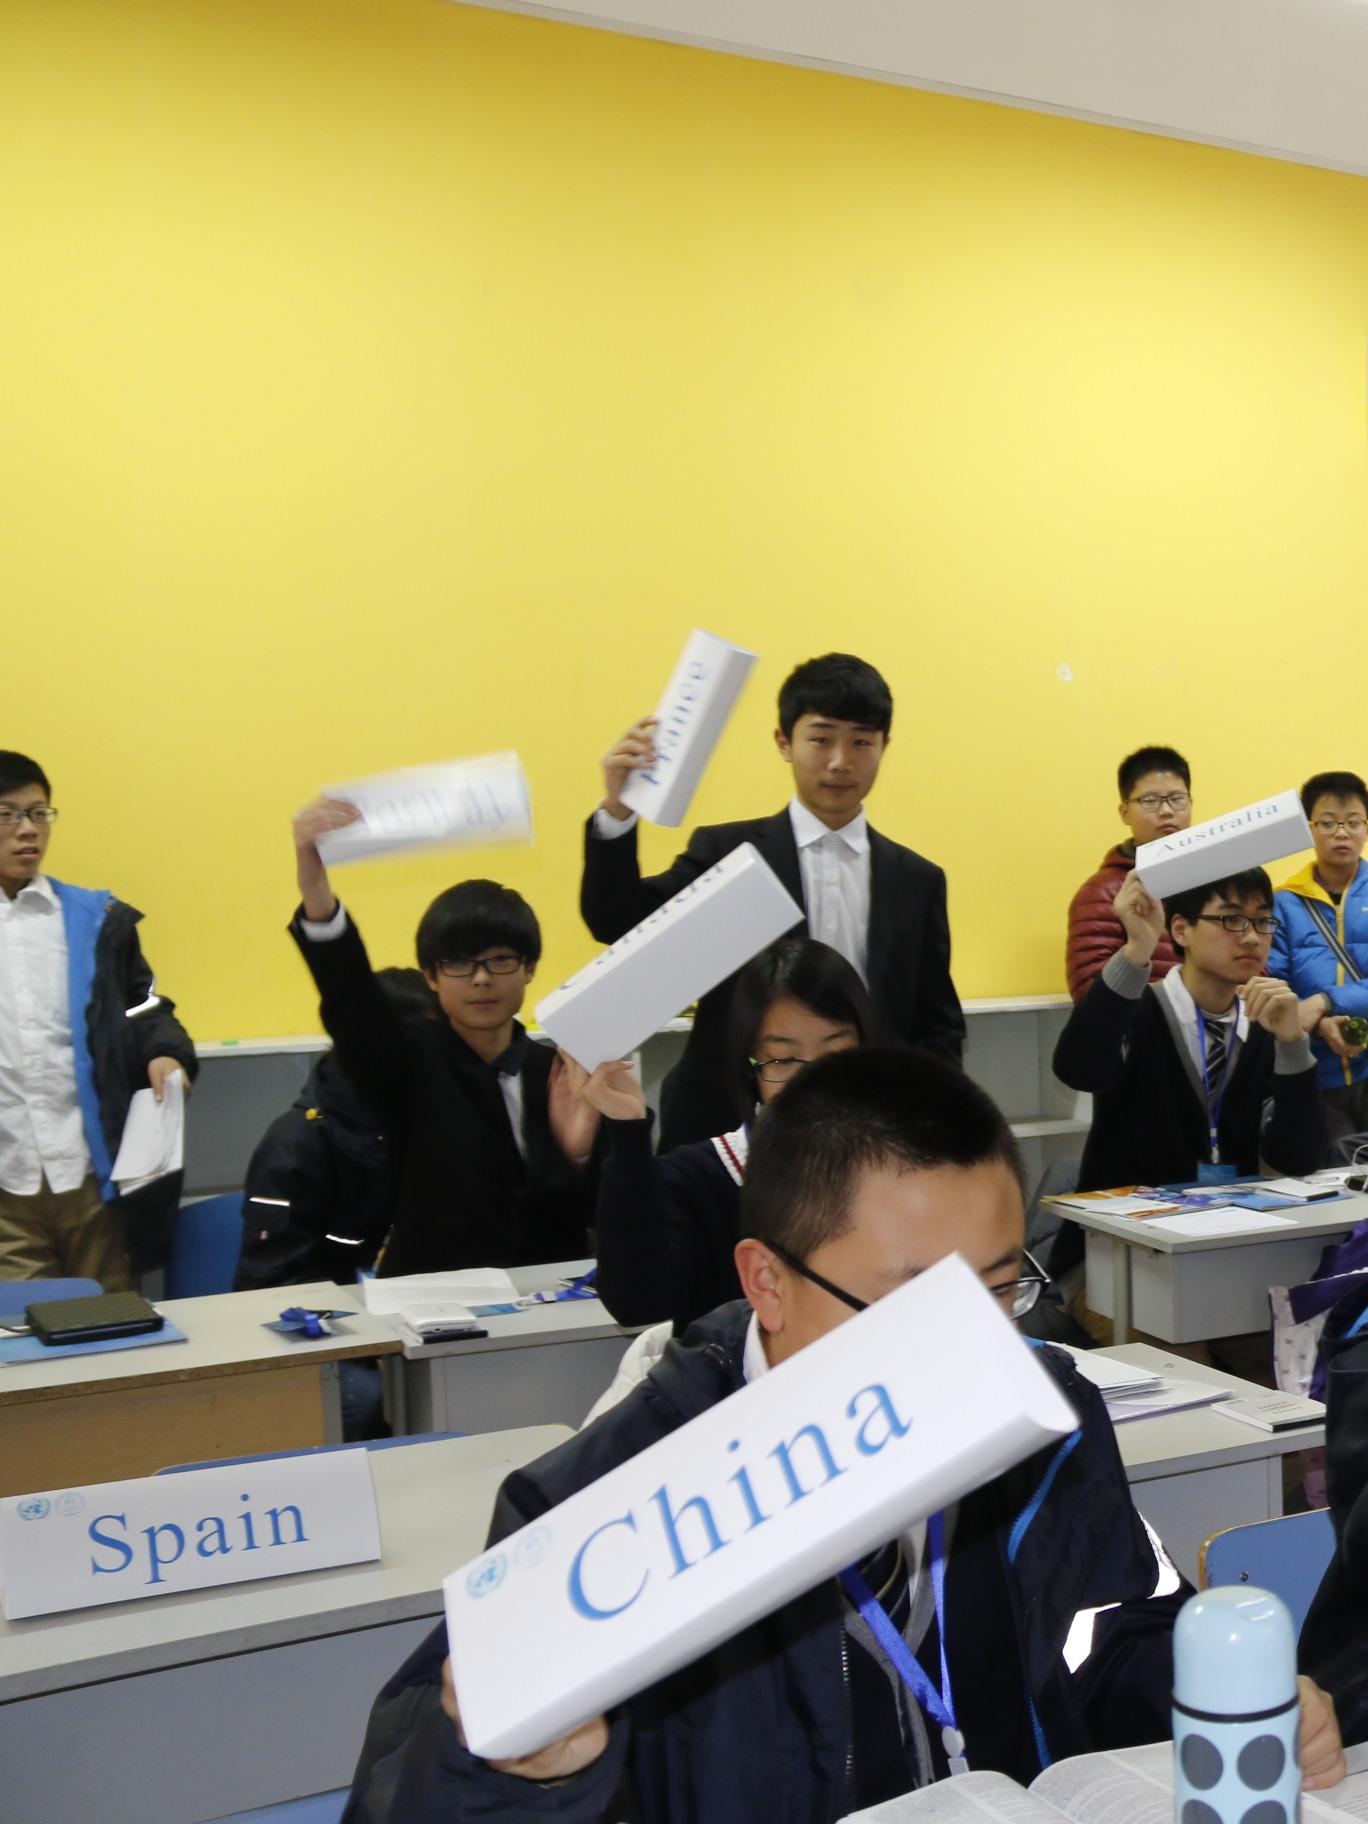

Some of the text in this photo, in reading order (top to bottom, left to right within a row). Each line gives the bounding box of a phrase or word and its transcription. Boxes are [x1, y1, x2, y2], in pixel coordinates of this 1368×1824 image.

[1155, 803, 1280, 857] Australia
[87, 1493, 311, 1585] Spain
[566, 1381, 913, 1622] China
